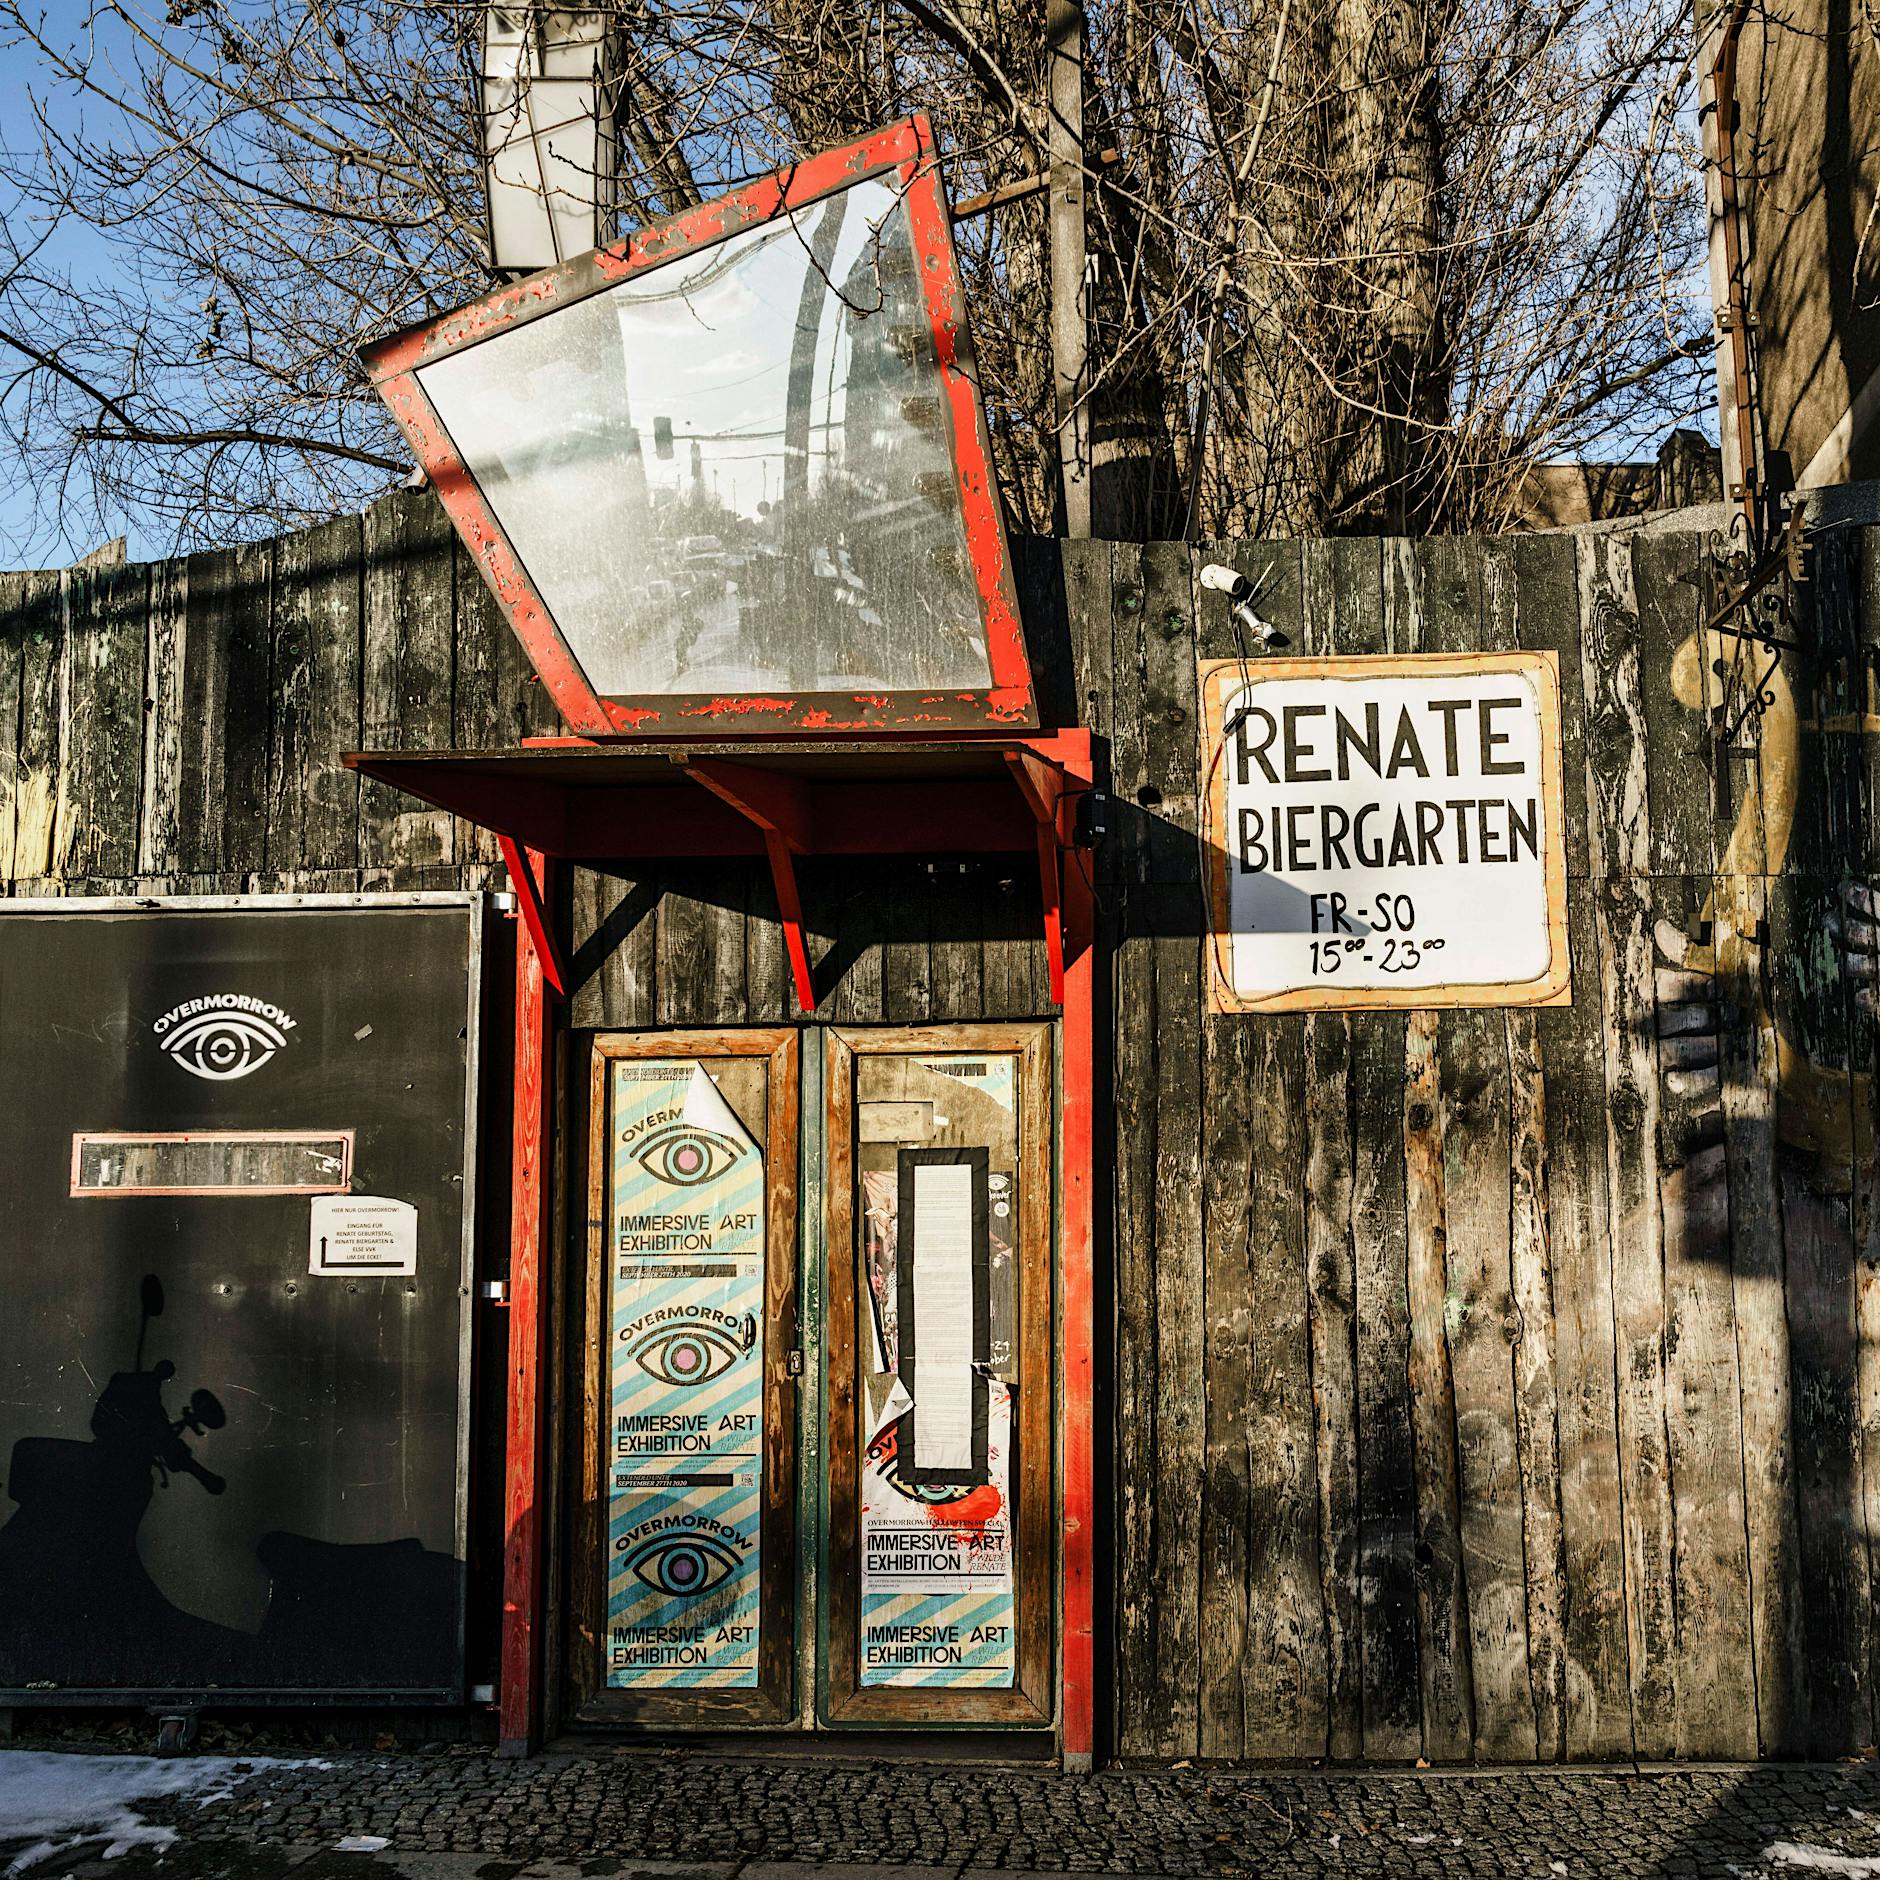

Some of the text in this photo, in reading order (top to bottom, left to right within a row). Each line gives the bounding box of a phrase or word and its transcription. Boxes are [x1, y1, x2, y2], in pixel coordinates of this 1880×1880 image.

[1234, 698, 1525, 785] RENATE
[1238, 798, 1538, 874] BIERGARTEN
[153, 993, 298, 1034] OVERMORROW
[620, 1214, 757, 1231] IMMERSIVE ART
[620, 1234, 712, 1251] EXHIBITION
[619, 1305, 743, 1342] OVERMORRO
[617, 1414, 757, 1432] IMMERSIVE ART
[617, 1434, 711, 1452] EXHIBITION
[615, 1514, 754, 1552] OVERMORROW
[867, 1534, 1005, 1551] IMMERSIVE ART
[867, 1554, 961, 1571] EXHIBITION
[970, 1562, 1007, 1571] RENATE
[613, 1626, 754, 1644] IMMERSIVE ART
[867, 1626, 1009, 1643] IMMERSIVE ART
[613, 1647, 707, 1664] EXHIBITION
[867, 1646, 962, 1663] EXHIBITION
